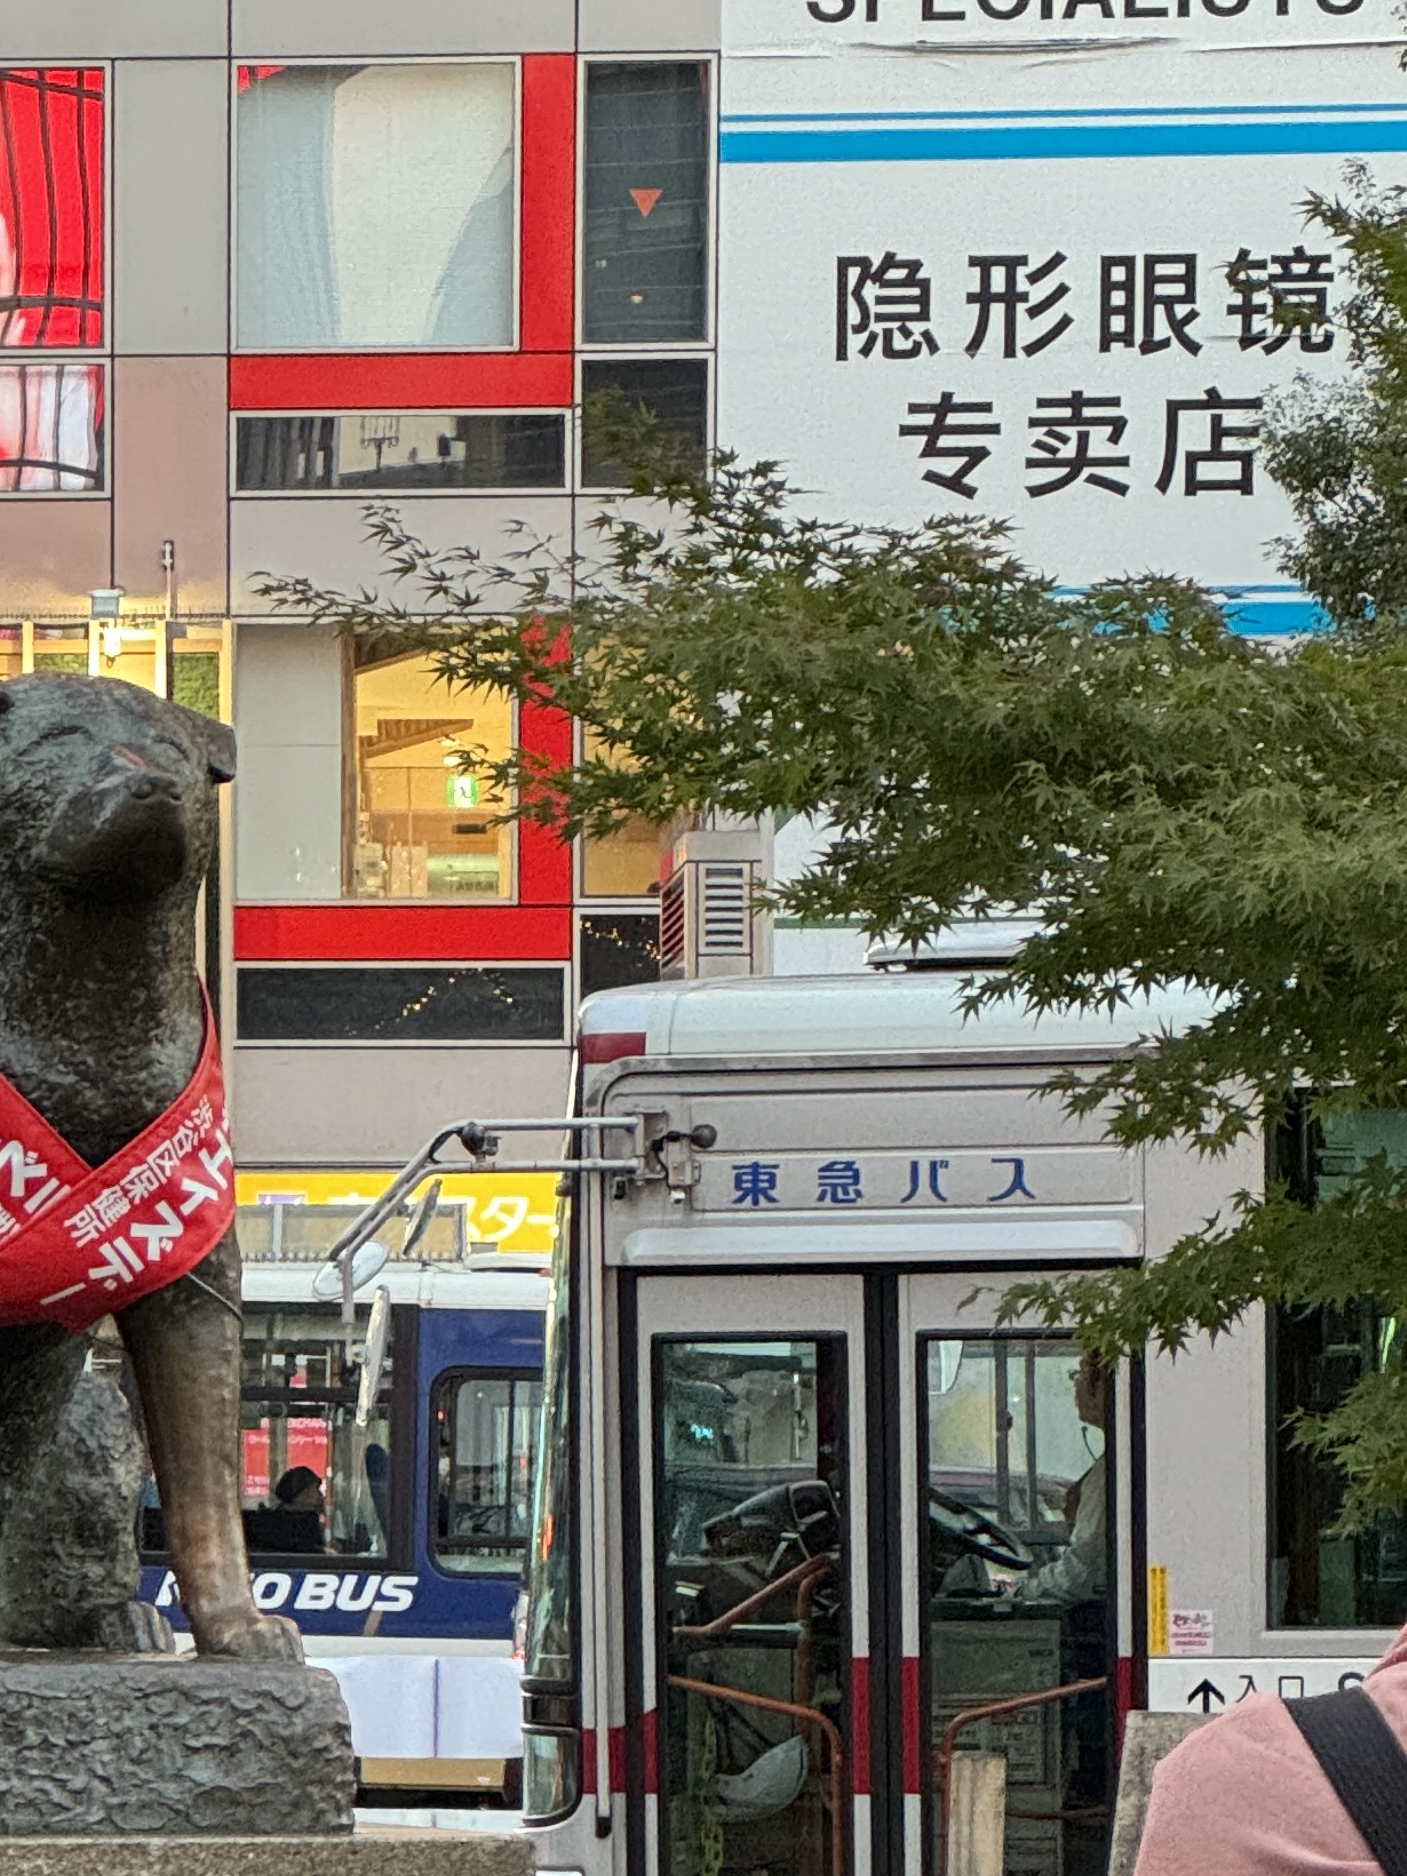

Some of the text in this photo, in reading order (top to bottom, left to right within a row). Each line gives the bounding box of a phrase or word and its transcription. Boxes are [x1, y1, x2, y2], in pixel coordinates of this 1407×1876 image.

[836, 246, 1334, 361] 隐形眼镜
[899, 386, 1264, 500] 专卖店
[40, 1107, 233, 1306] エイズデー
[63, 1094, 214, 1249] 渋谷区保健所
[731, 1157, 1036, 1206] 東急バス
[293, 1574, 419, 1612] BUS
